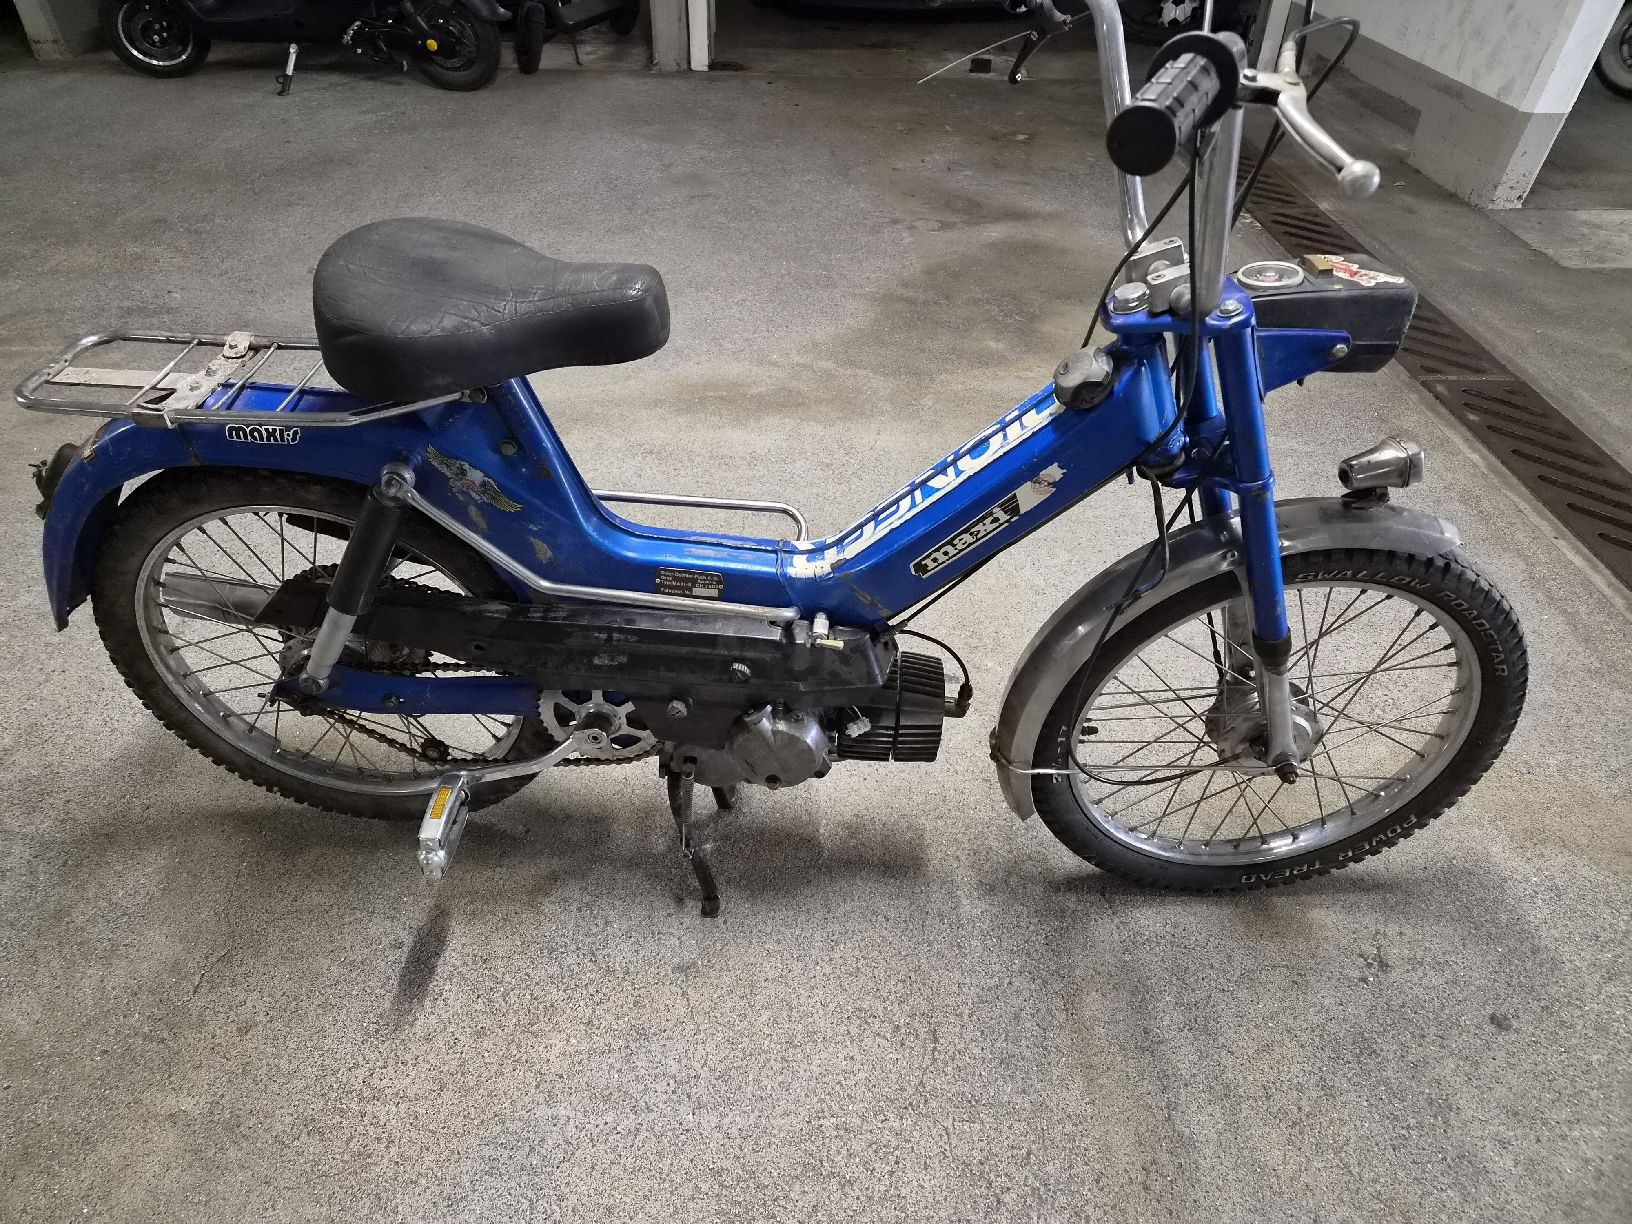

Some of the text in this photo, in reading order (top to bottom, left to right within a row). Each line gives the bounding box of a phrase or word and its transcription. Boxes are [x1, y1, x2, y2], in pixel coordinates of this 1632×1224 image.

[919, 505, 1013, 572] maxi
[1294, 568, 1508, 678] SWALLOW ROADSTAR
[1241, 814, 1418, 884] POWER TREAD
